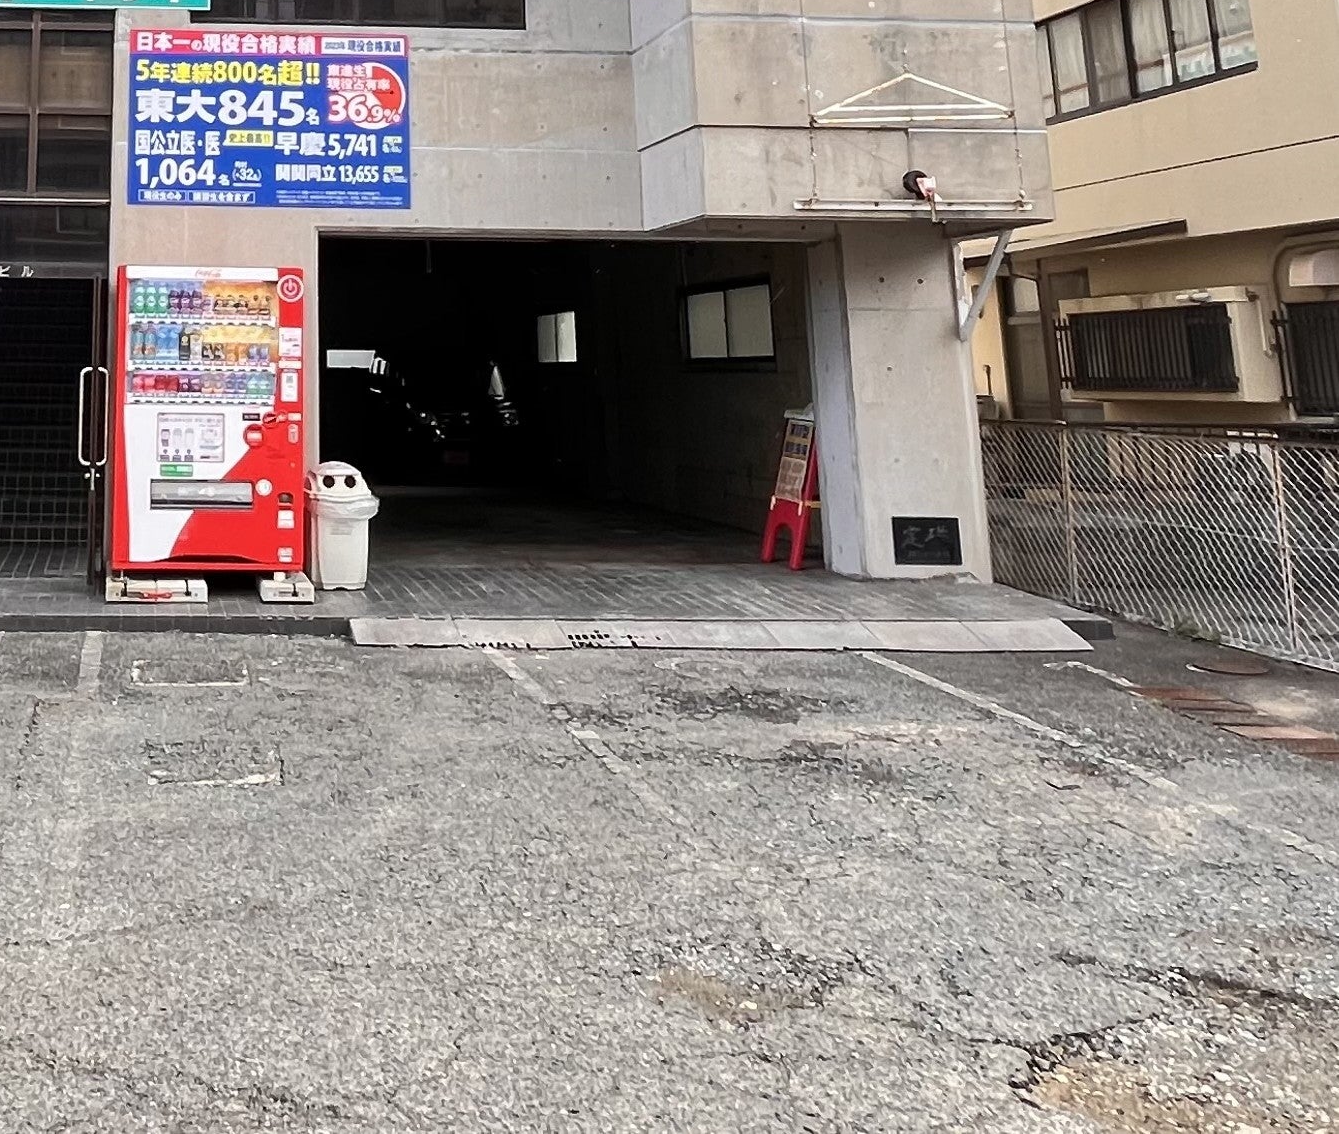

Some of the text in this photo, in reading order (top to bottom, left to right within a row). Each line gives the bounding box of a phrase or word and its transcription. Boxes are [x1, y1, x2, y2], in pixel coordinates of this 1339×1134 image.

[136, 32, 316, 55] 日本一の現役合格実績
